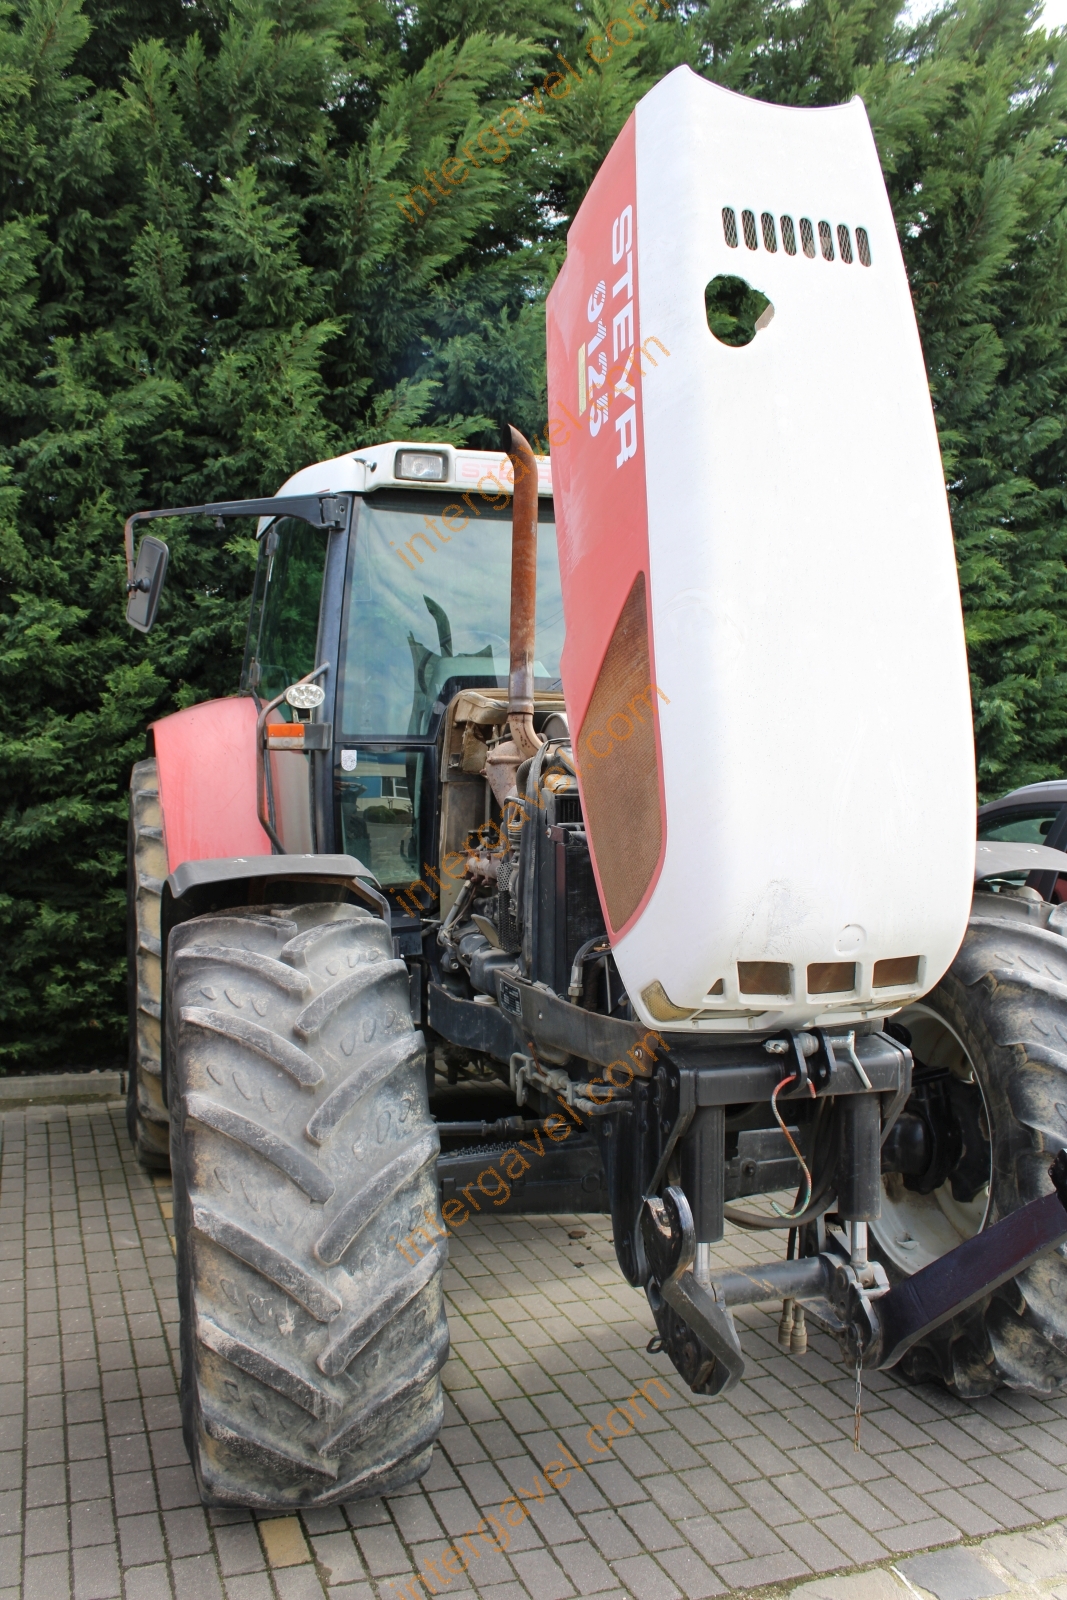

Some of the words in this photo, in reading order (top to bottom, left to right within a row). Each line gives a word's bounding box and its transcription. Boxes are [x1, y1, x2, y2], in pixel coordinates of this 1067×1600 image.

[587, 280, 609, 437] 9125
[612, 204, 638, 469] STEYR
[462, 463, 552, 483] STER
